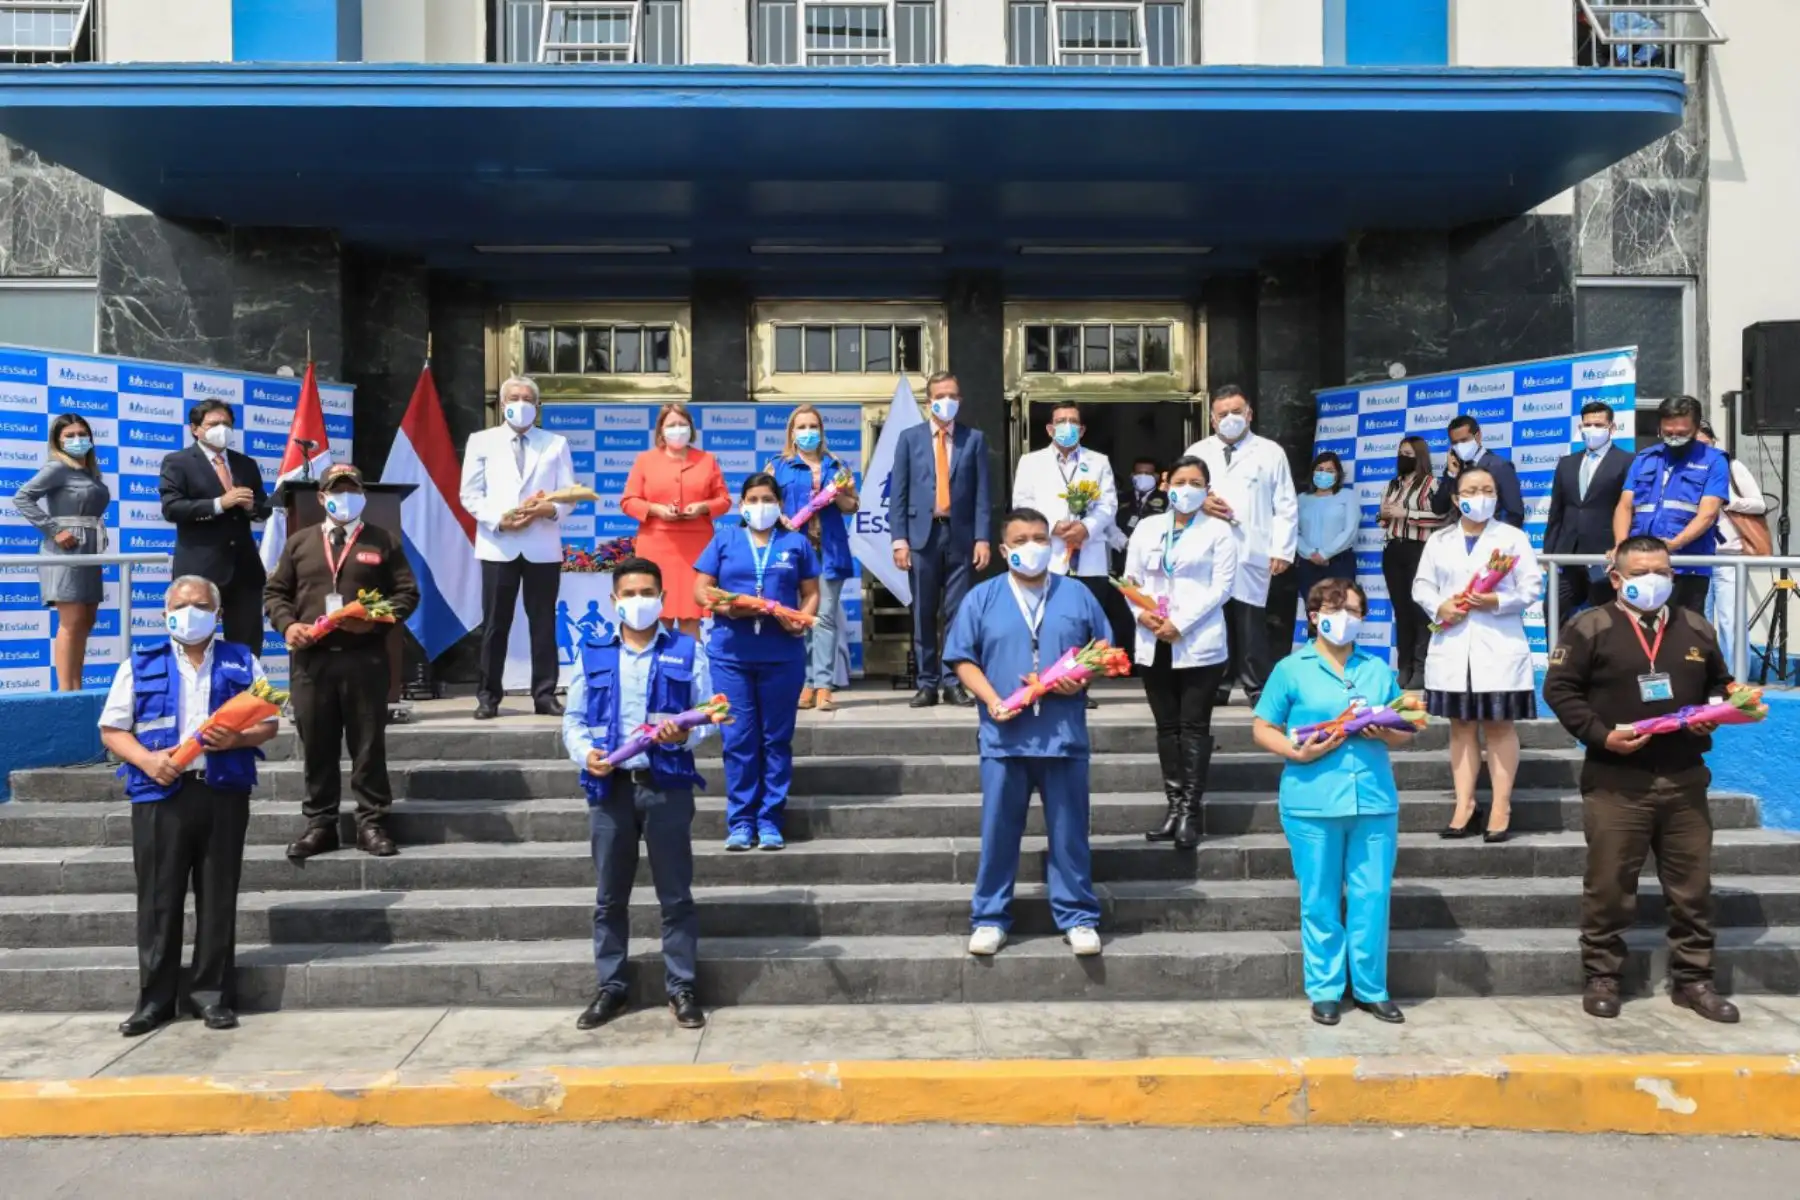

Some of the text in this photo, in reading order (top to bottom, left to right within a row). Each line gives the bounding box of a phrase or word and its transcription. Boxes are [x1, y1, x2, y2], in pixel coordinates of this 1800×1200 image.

[3, 366, 37, 377] EsSalud
[3, 422, 38, 433] EsSalud
[4, 535, 38, 546] EsSalud
[4, 622, 39, 631] EsSalud
[5, 650, 39, 660] EsSalud
[6, 678, 40, 688] EsSalud
